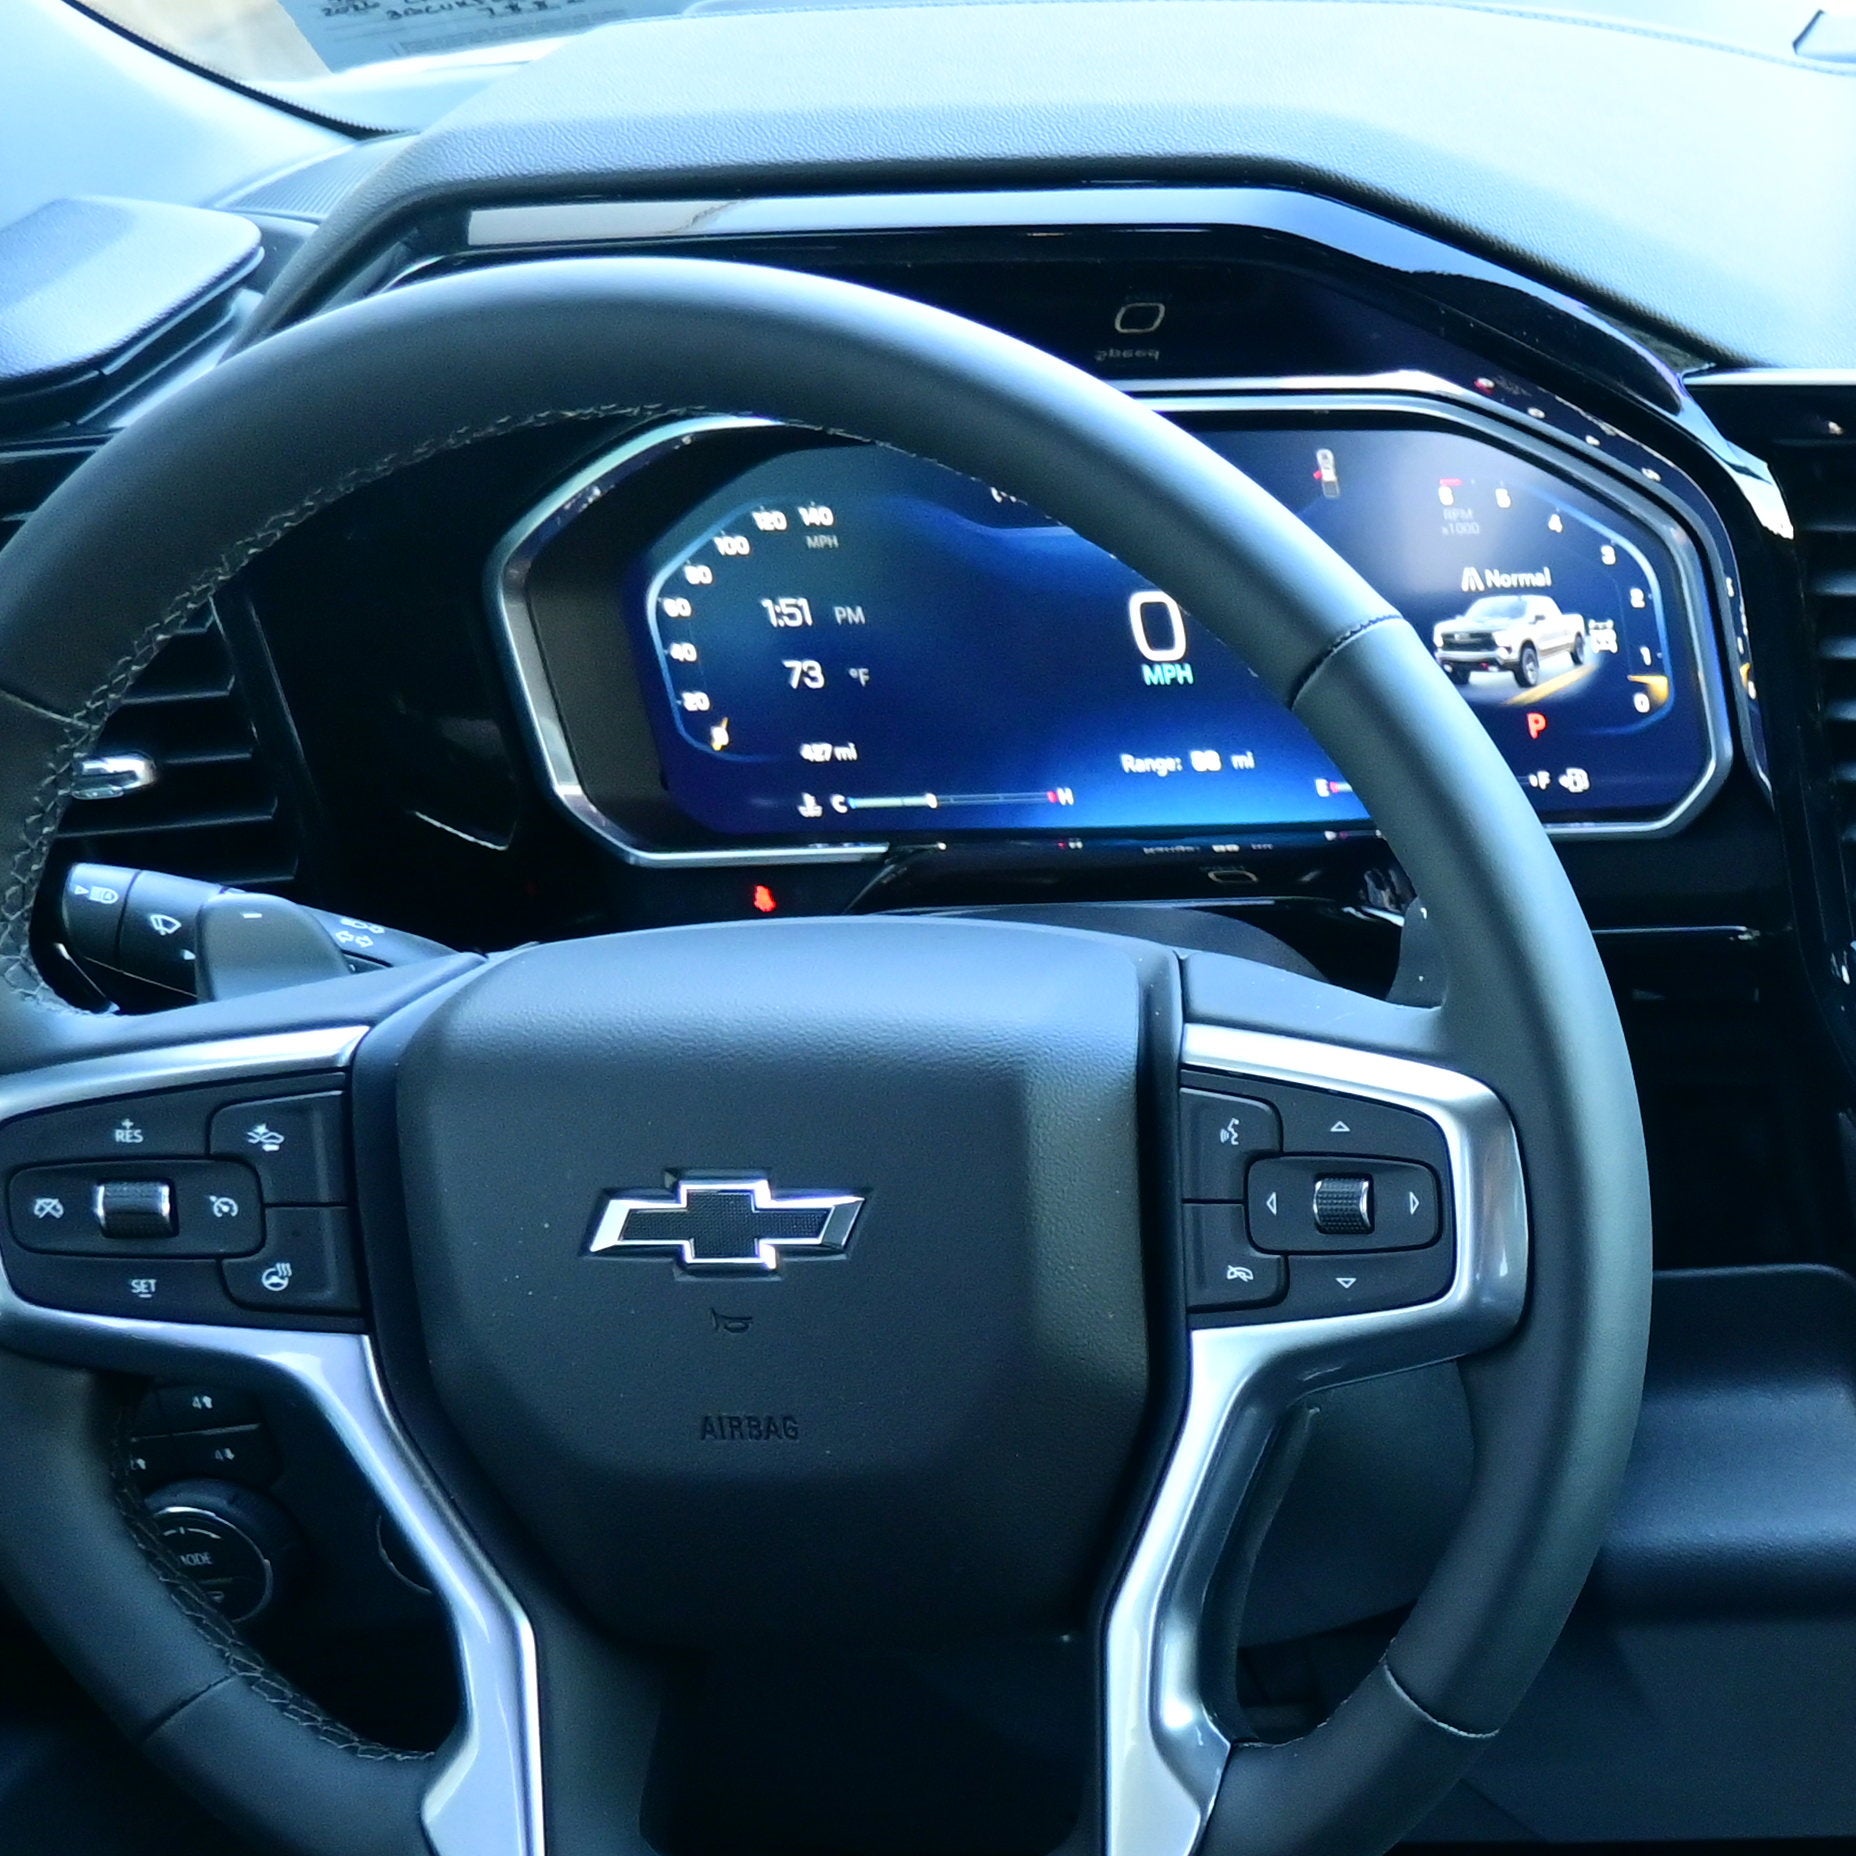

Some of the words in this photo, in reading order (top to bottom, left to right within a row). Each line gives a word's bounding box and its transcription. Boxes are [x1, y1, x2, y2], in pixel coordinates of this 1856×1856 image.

[713, 535, 751, 556] 100
[805, 534, 839, 550] MPH
[1484, 566, 1553, 589] Normal
[760, 597, 814, 628] 1:51
[833, 605, 866, 626] PM
[1128, 590, 1187, 662] 0
[669, 642, 698, 662] 40
[1640, 646, 1652, 666] 1
[782, 659, 826, 689] 73
[1141, 663, 1195, 686] MPH
[1526, 713, 1548, 738] P
[833, 741, 858, 761] mi
[1120, 753, 1184, 777] Range:
[1230, 751, 1256, 770] mi
[829, 793, 849, 814] C
[114, 1128, 145, 1144] RES
[130, 1278, 158, 1294] SET
[700, 1413, 800, 1442] AIRBAG
